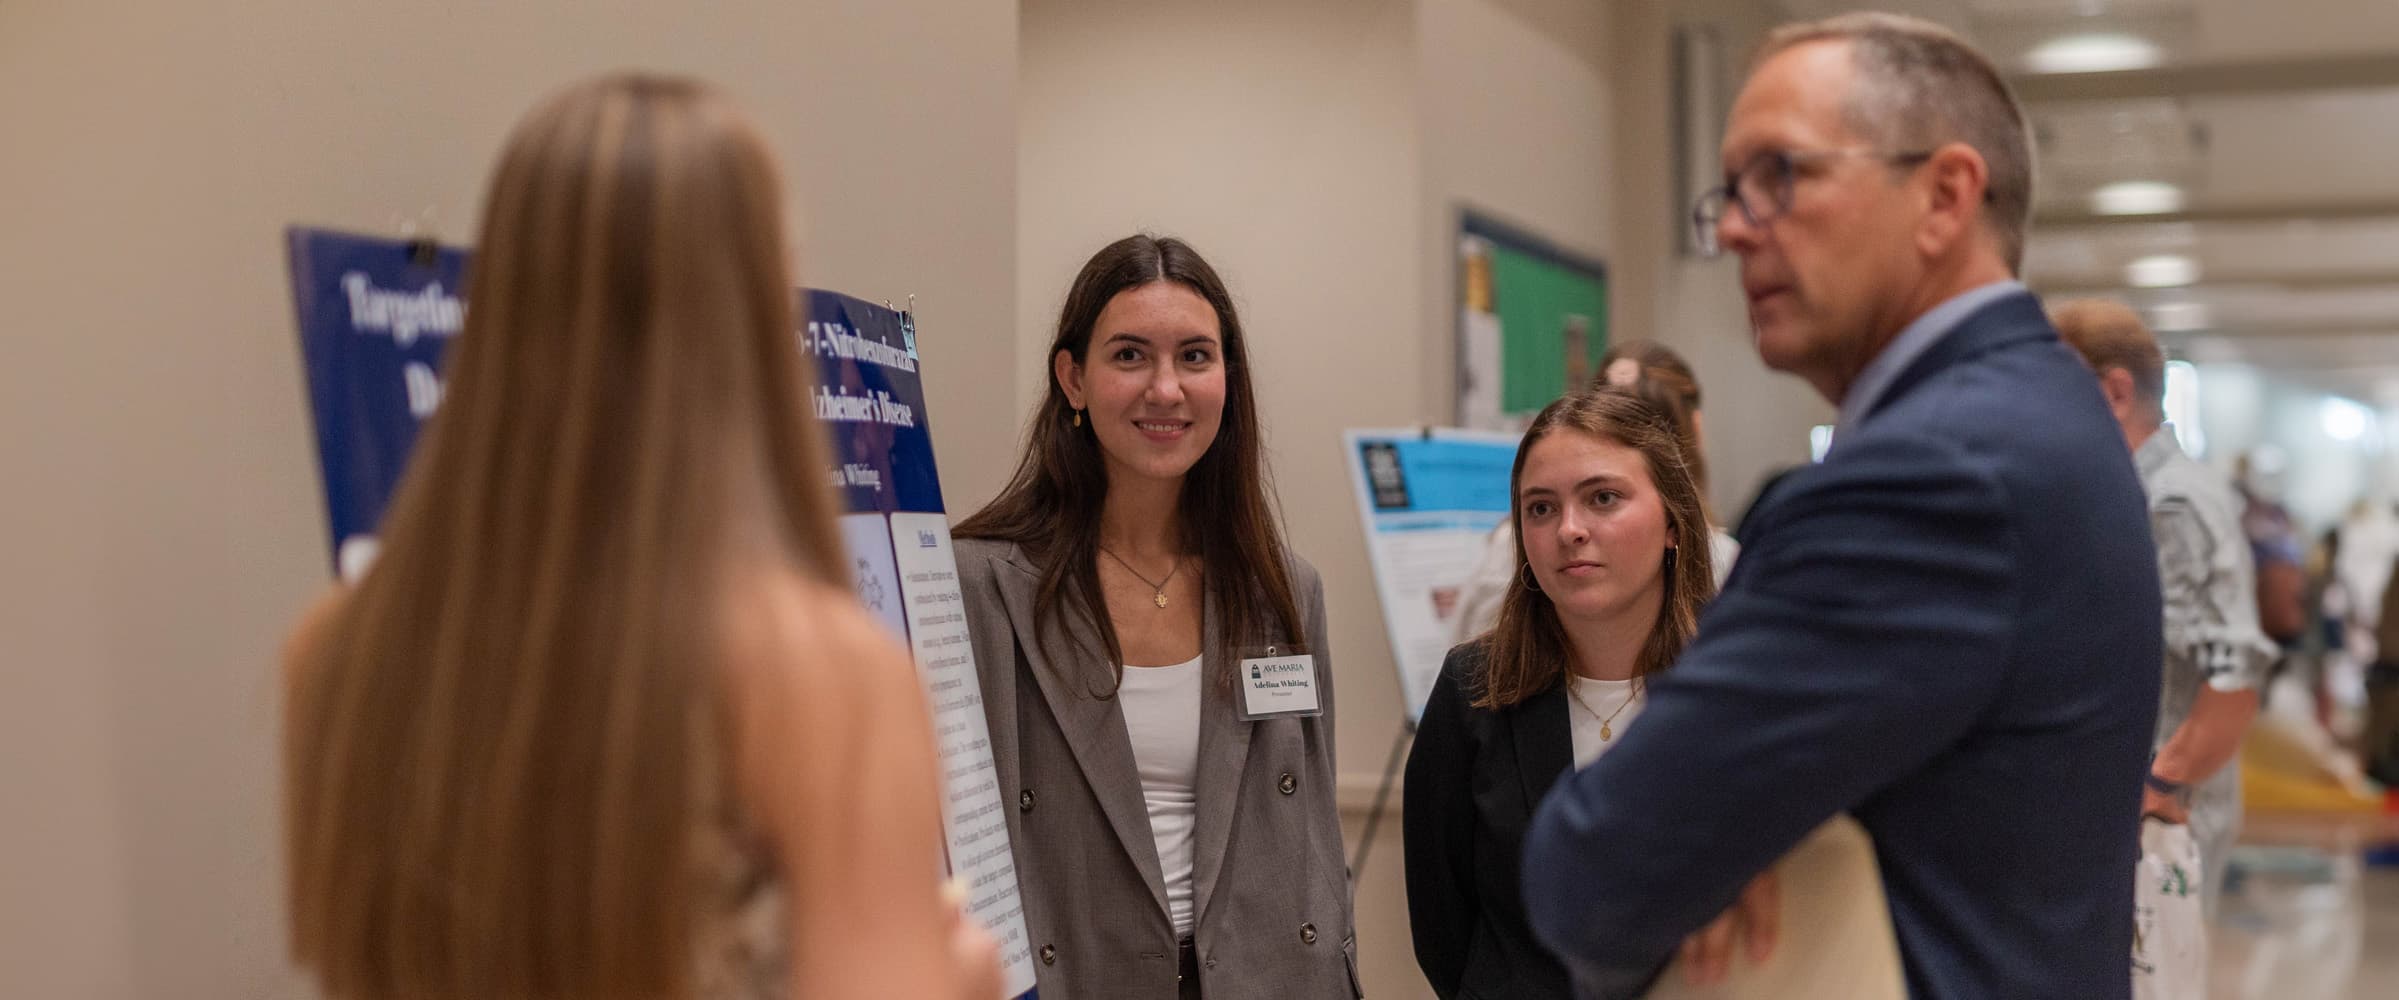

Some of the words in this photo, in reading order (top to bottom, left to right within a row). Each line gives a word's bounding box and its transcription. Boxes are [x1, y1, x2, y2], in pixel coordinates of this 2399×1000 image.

[341, 271, 468, 348] Targetin
[808, 385, 881, 422] lzheimer's
[876, 390, 915, 428] Disease
[1279, 664, 1304, 672] MARIA
[1253, 681, 1280, 689] Adelina
[1280, 679, 1309, 688] Whiting
